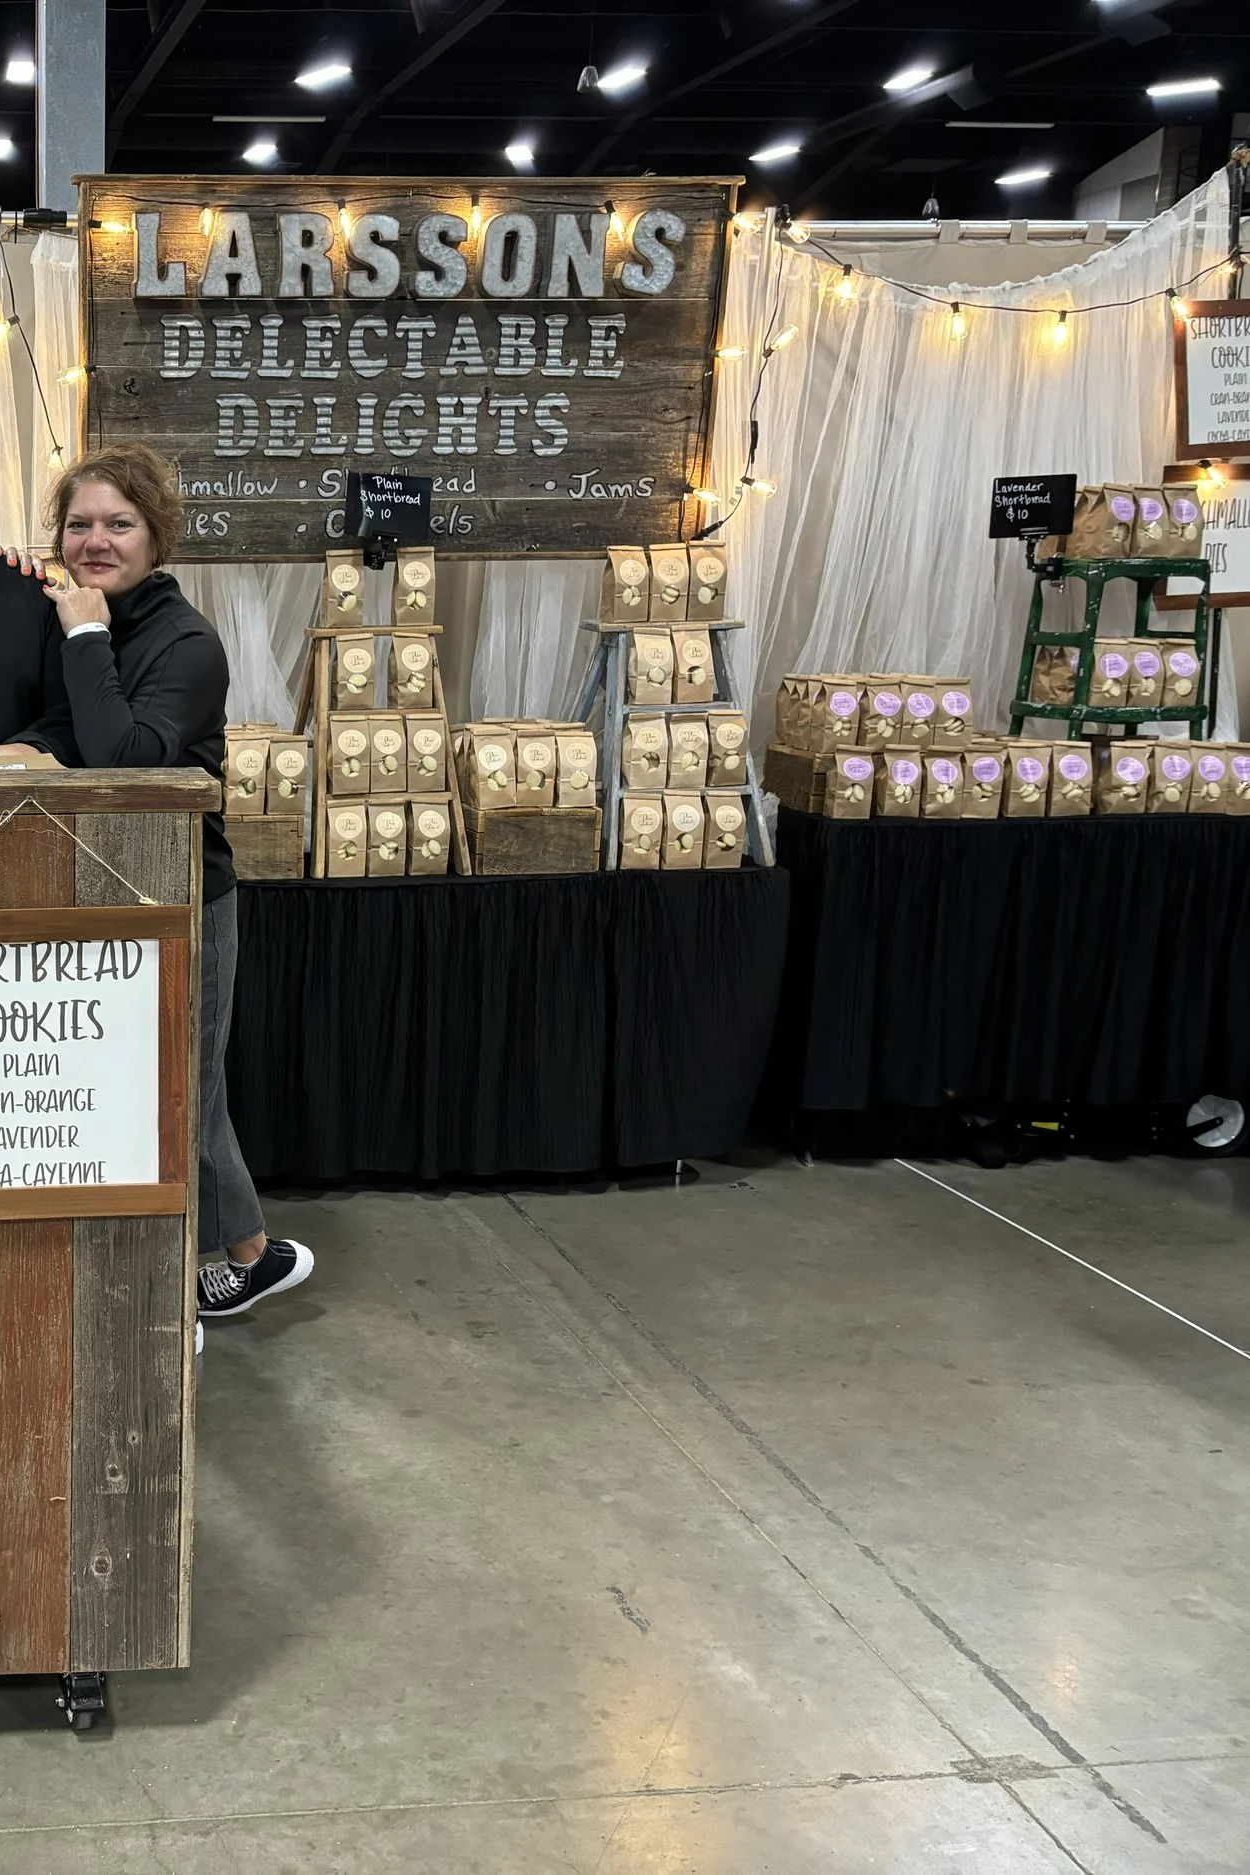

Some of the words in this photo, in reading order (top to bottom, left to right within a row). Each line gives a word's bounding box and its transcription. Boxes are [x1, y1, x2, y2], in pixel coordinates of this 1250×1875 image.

[132, 209, 685, 297] LARSSONS
[159, 313, 627, 379] DELECTABLE
[214, 393, 569, 457] DELIGHTS
[177, 468, 278, 498] hmallow
[567, 468, 654, 499] Jams
[372, 476, 403, 491] Plain
[995, 479, 1044, 494] Lavender
[360, 490, 421, 506] Shortbread
[994, 492, 1051, 508] Shortbread
[186, 508, 231, 537] ies
[3, 1052, 60, 1078] PLAIN
